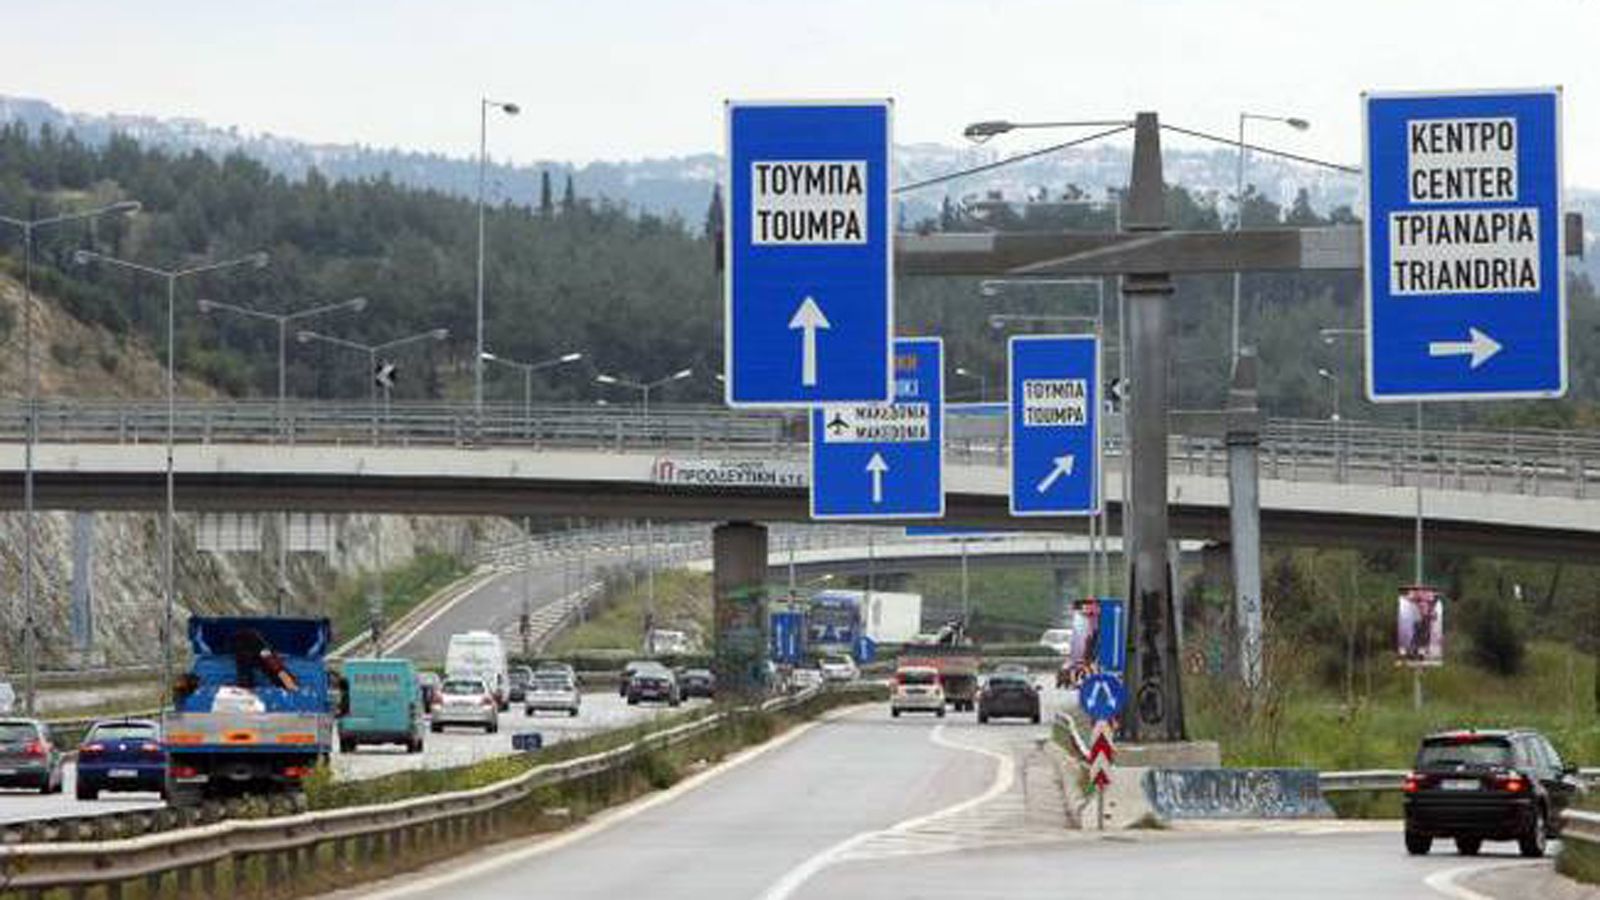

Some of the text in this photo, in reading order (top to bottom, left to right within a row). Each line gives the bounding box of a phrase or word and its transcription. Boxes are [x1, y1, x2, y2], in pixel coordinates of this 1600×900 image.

[1411, 121, 1514, 154] ΚΕΝΤΡΟ
[756, 164, 862, 195] ΤΟΥΜΠΑ
[1412, 166, 1514, 200] CENTER
[757, 210, 861, 241] TOUMPA
[1393, 212, 1534, 246] ΤΡΙΑΝΔΡΙΑ
[1393, 258, 1536, 291] TRIANDRIA
[1025, 382, 1085, 399] ΤΟΥΜΠΑ
[1025, 406, 1085, 423] TOUMPA
